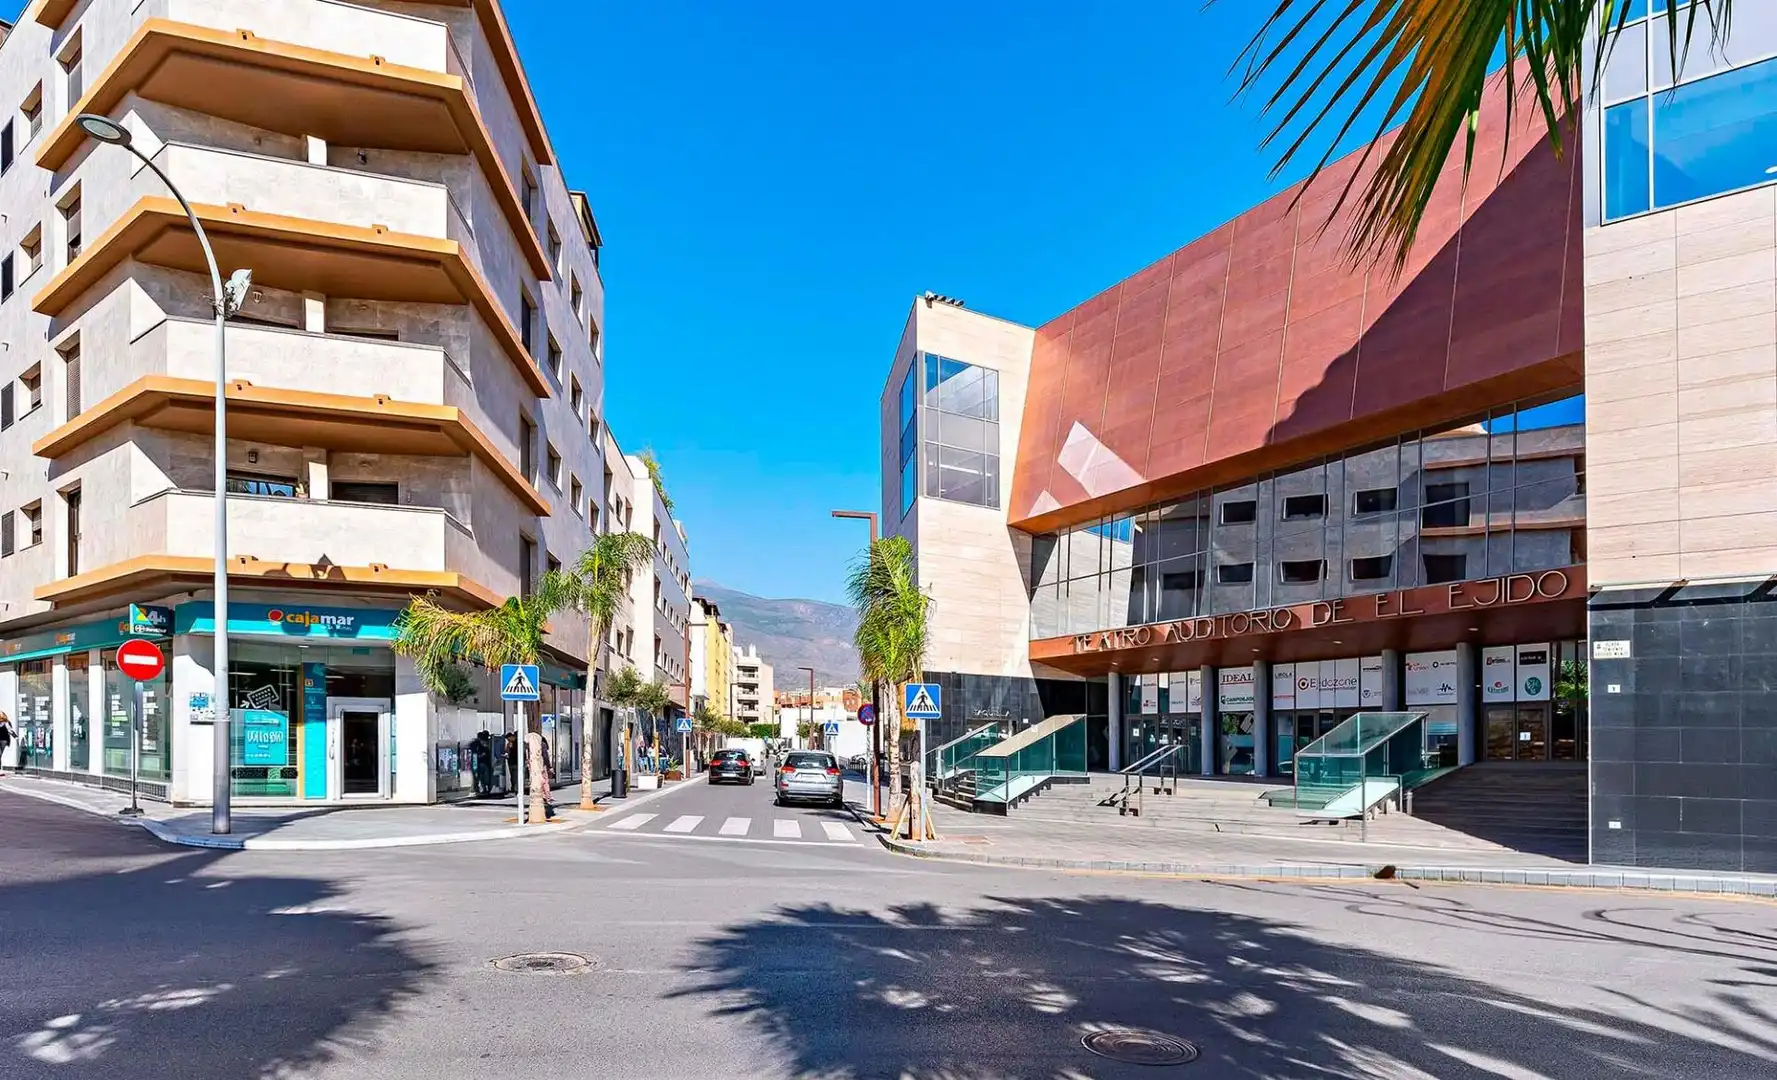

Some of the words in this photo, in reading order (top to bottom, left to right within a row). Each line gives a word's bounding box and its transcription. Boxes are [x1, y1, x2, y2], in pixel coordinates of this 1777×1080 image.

[285, 611, 355, 627] cajamar
[1074, 626, 1151, 654] TEATRO
[1164, 608, 1292, 642] AUDITORIO
[1312, 600, 1354, 626] DE
[1375, 591, 1424, 618] EL
[1449, 570, 1568, 610] EJIDO
[1222, 672, 1255, 682] IDEAL
